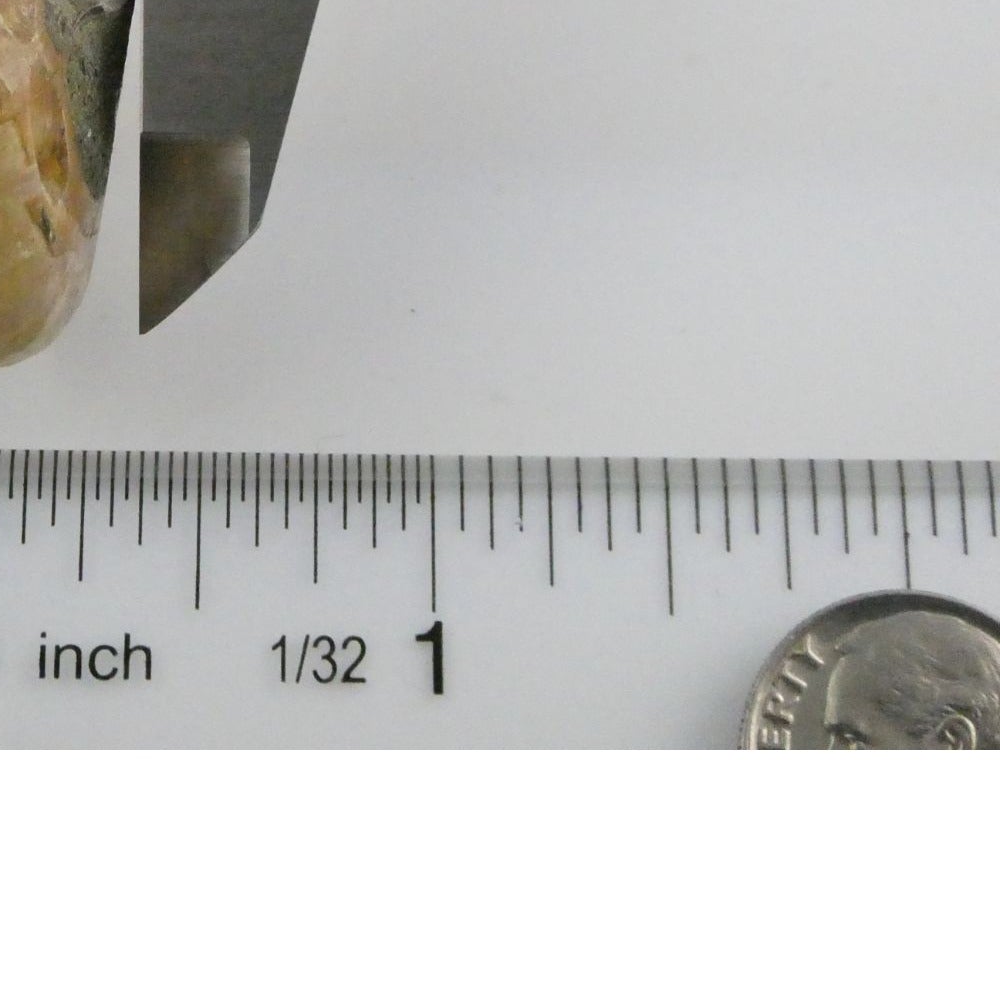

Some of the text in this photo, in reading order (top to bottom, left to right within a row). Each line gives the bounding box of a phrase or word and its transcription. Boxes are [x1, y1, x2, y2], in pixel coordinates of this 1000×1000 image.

[37, 632, 152, 682] inch
[271, 634, 367, 684] 1/32
[415, 620, 444, 696] 1
